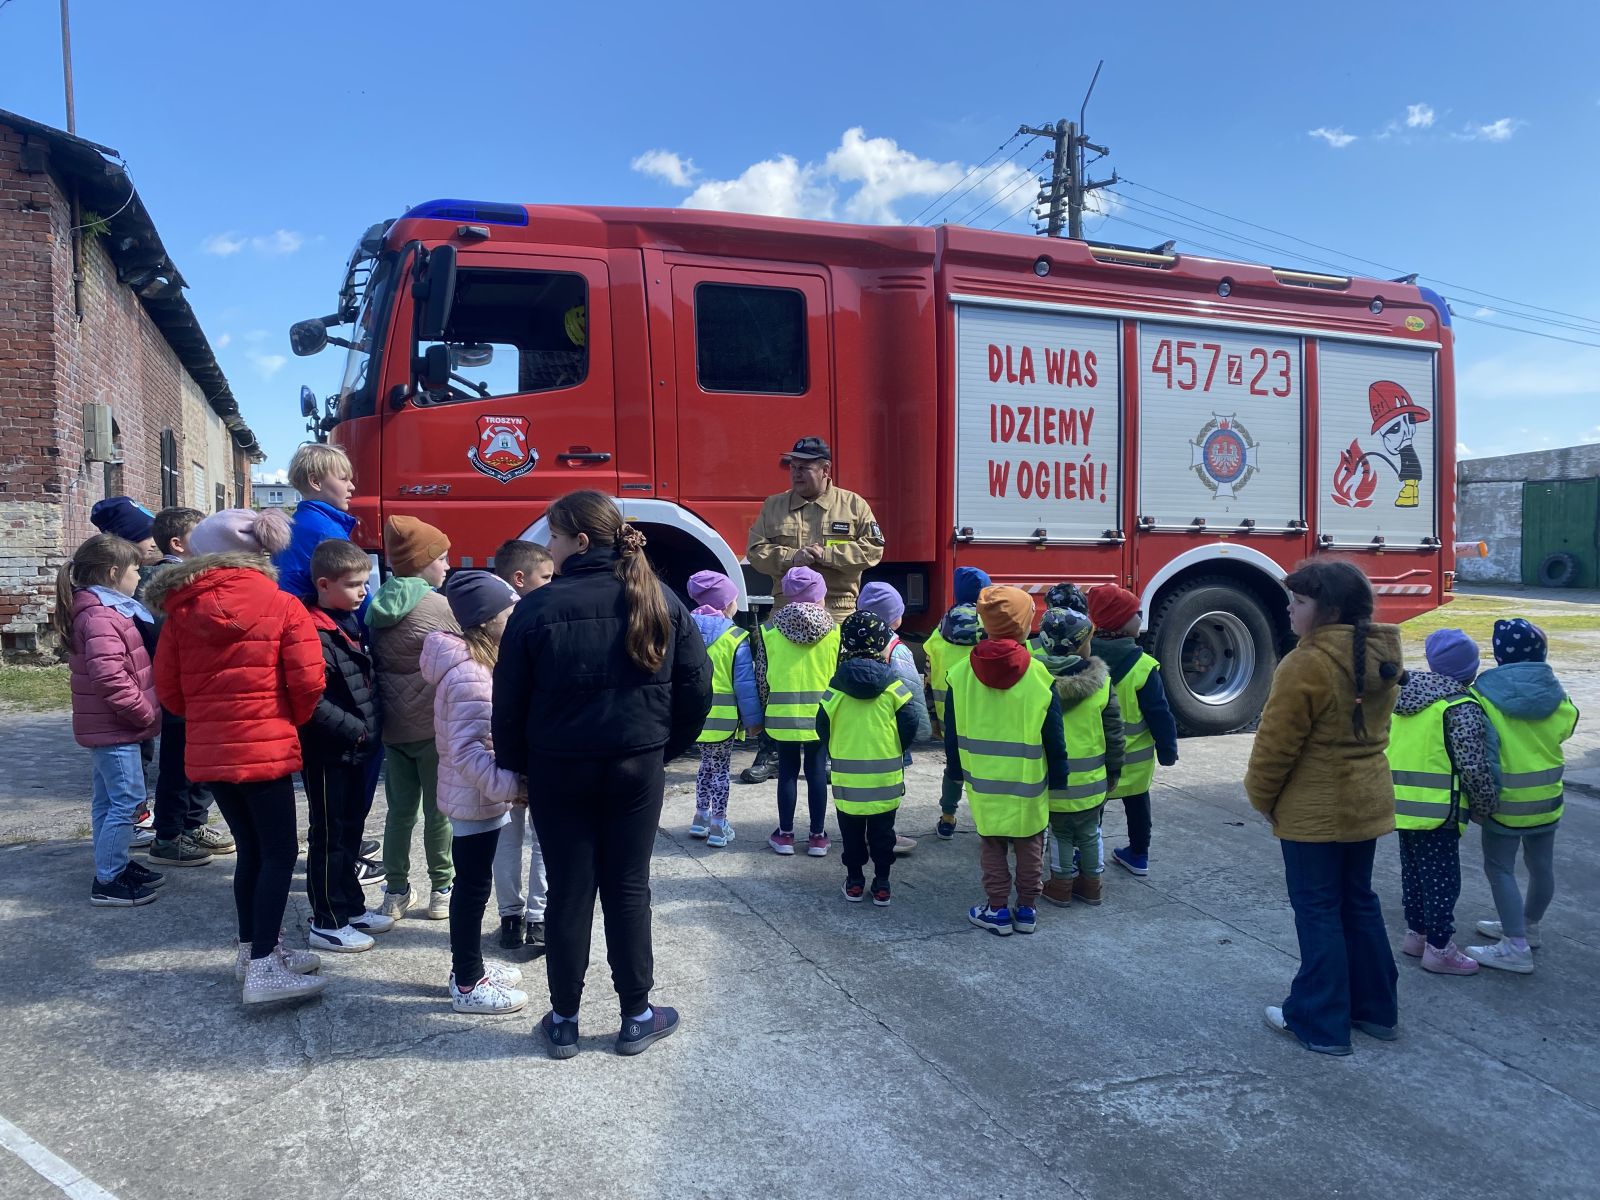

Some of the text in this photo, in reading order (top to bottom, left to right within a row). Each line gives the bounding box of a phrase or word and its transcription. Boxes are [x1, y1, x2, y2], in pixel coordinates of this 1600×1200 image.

[987, 344, 1098, 388] DLA WAS
[1151, 339, 1292, 397] 457 Z 23
[485, 416, 523, 425] TROSZYN
[989, 403, 1095, 446] IDZIEMY
[988, 453, 1107, 503] W OGIEŃ!
